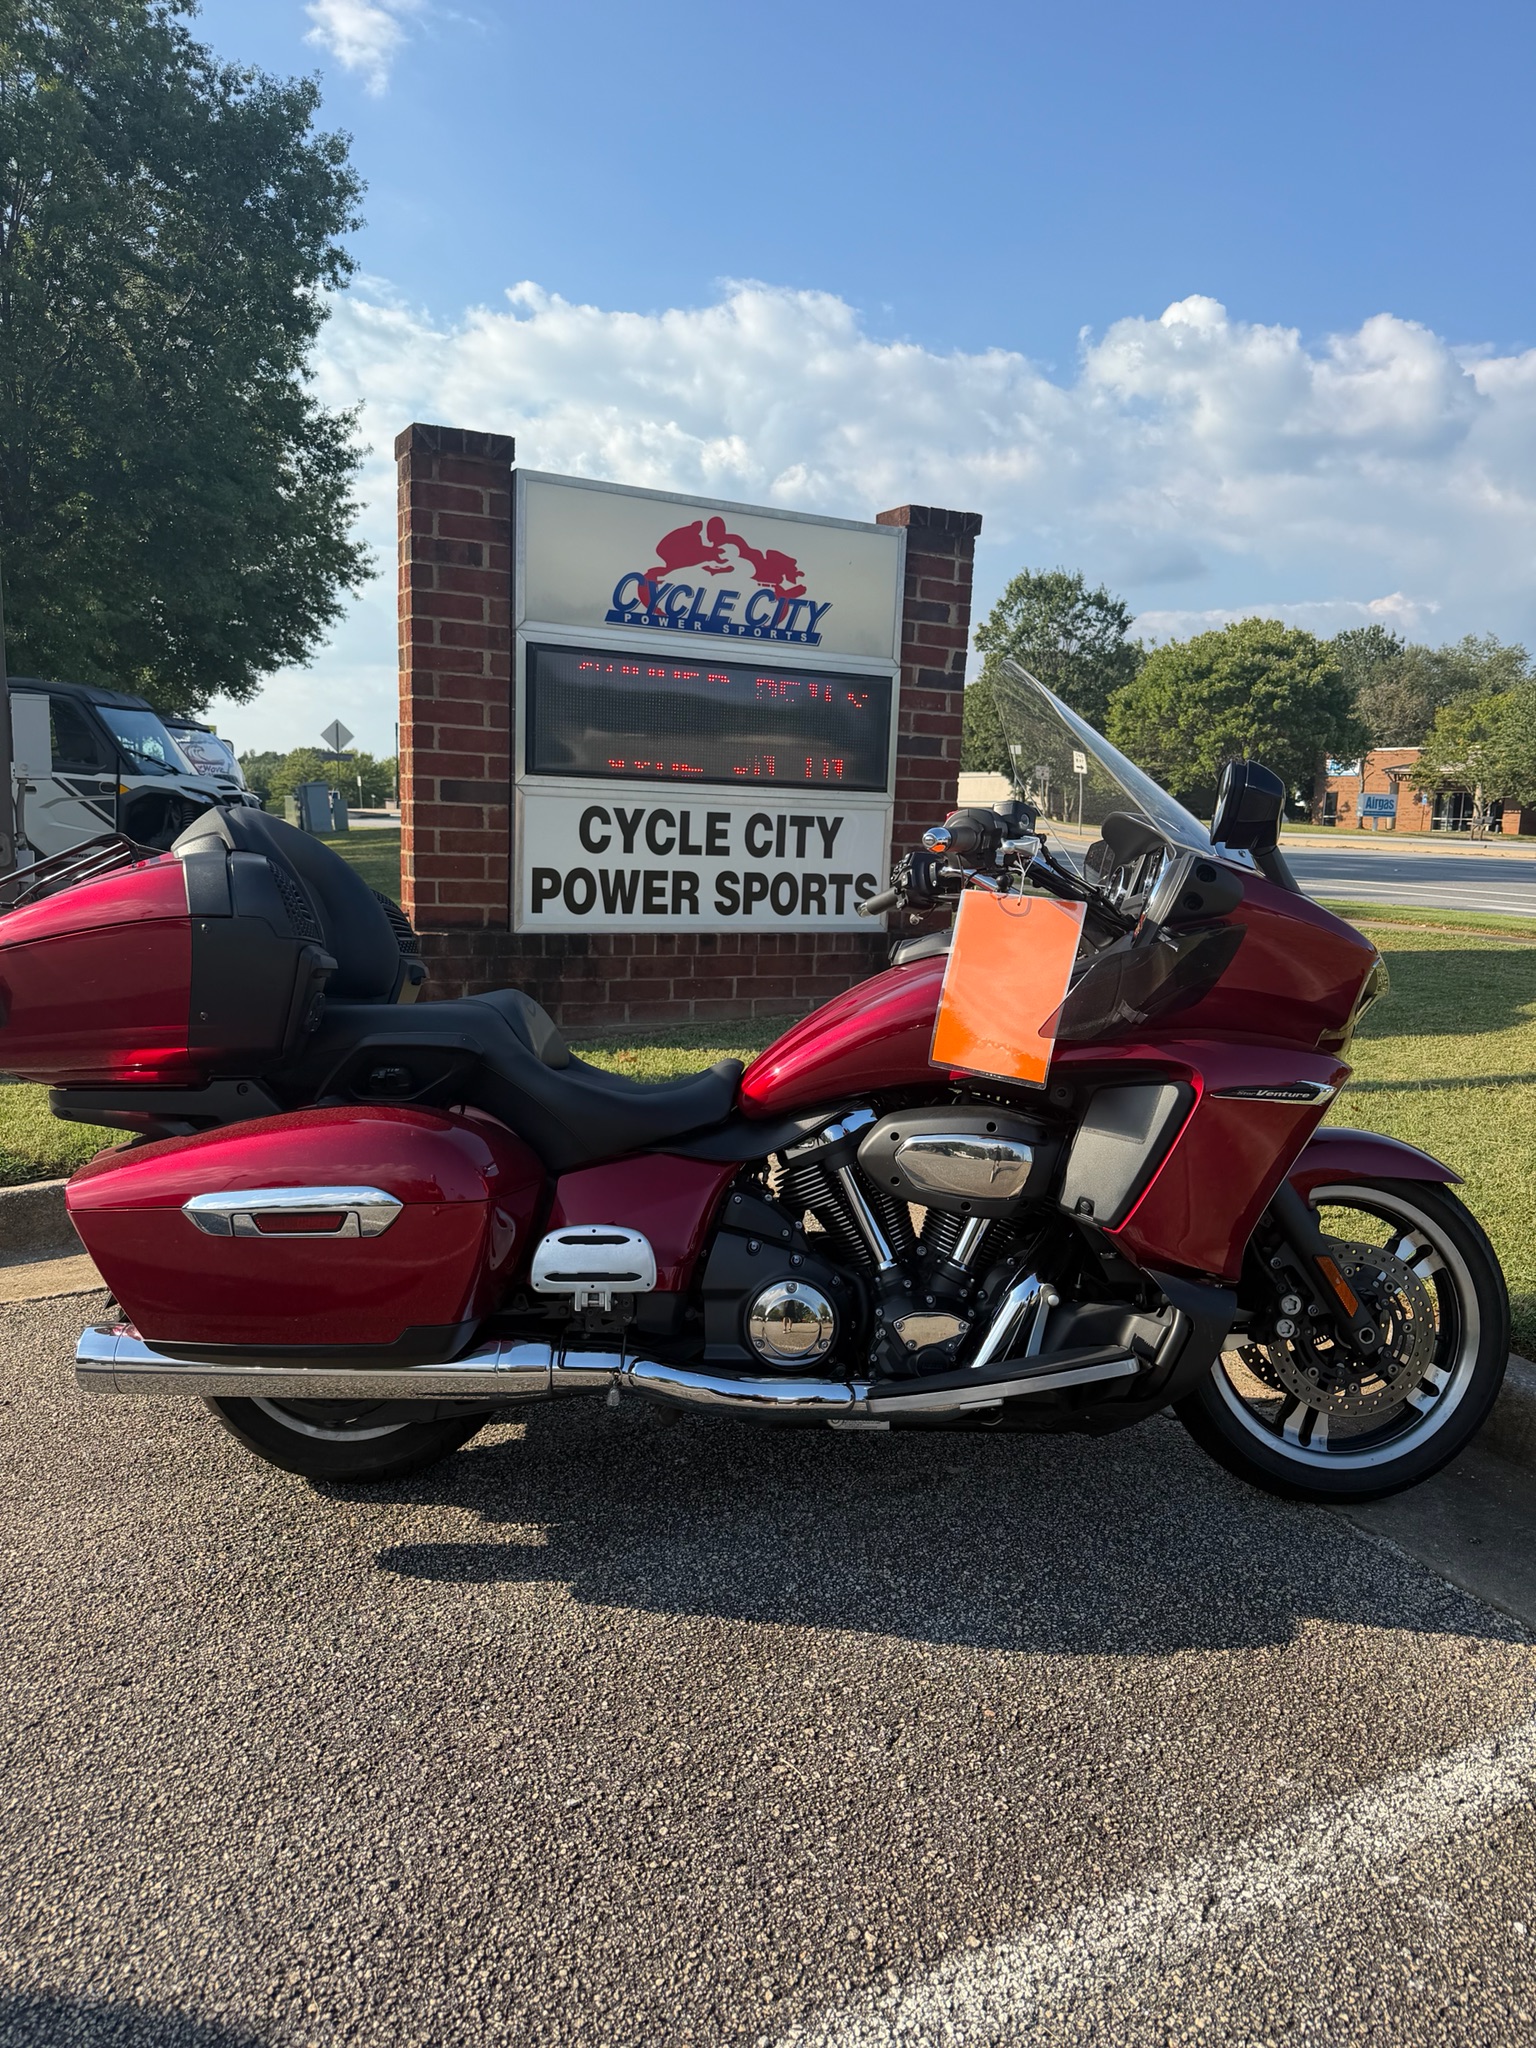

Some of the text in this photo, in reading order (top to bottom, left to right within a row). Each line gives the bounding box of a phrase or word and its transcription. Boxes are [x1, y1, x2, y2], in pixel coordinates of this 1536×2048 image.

[612, 571, 834, 634] CYCLE CITY
[624, 613, 808, 642] POWER SPORTS
[1365, 796, 1395, 810] Airgas
[579, 805, 844, 859] CYCLE CITY
[531, 867, 878, 916] POWER SPORTS
[1256, 1089, 1310, 1098] Venture
